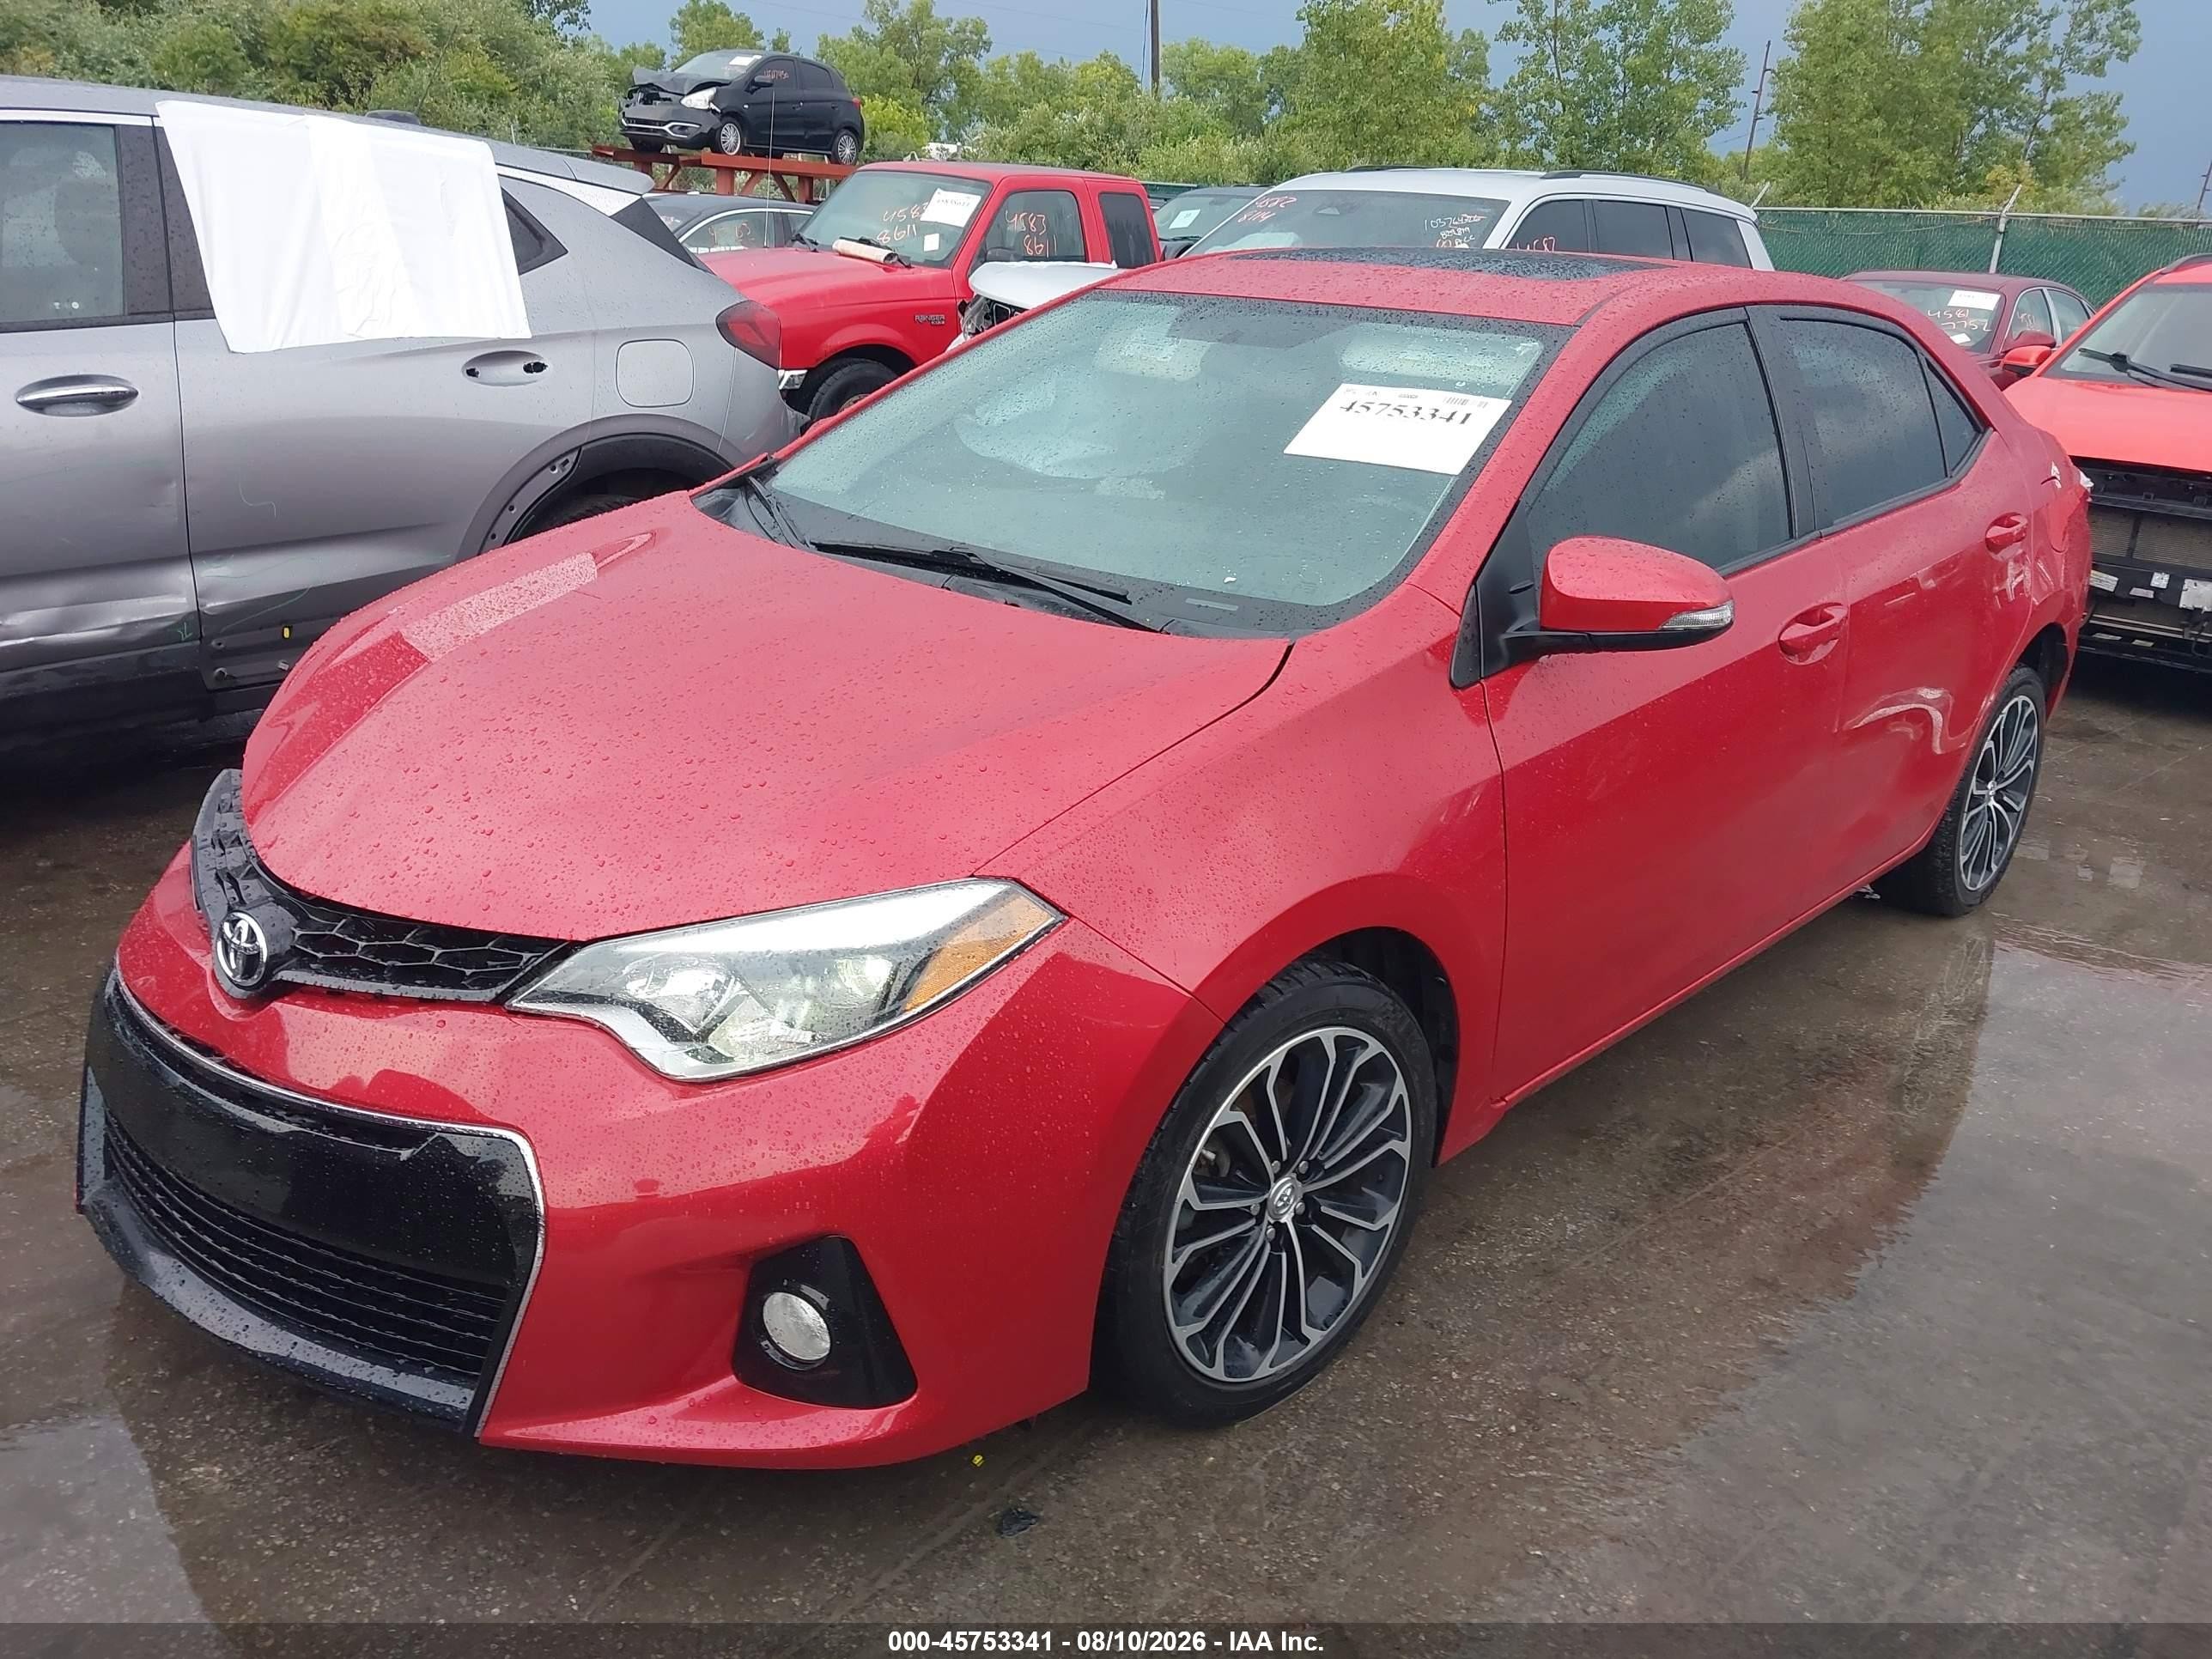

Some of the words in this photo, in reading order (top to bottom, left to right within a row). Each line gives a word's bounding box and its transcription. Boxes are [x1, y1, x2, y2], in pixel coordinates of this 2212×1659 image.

[877, 223, 917, 244] 8611
[1005, 210, 1047, 235] 4583
[1024, 234, 1058, 258] 8611
[1927, 308, 1969, 319] 4581
[1340, 400, 1472, 425] 45753341
